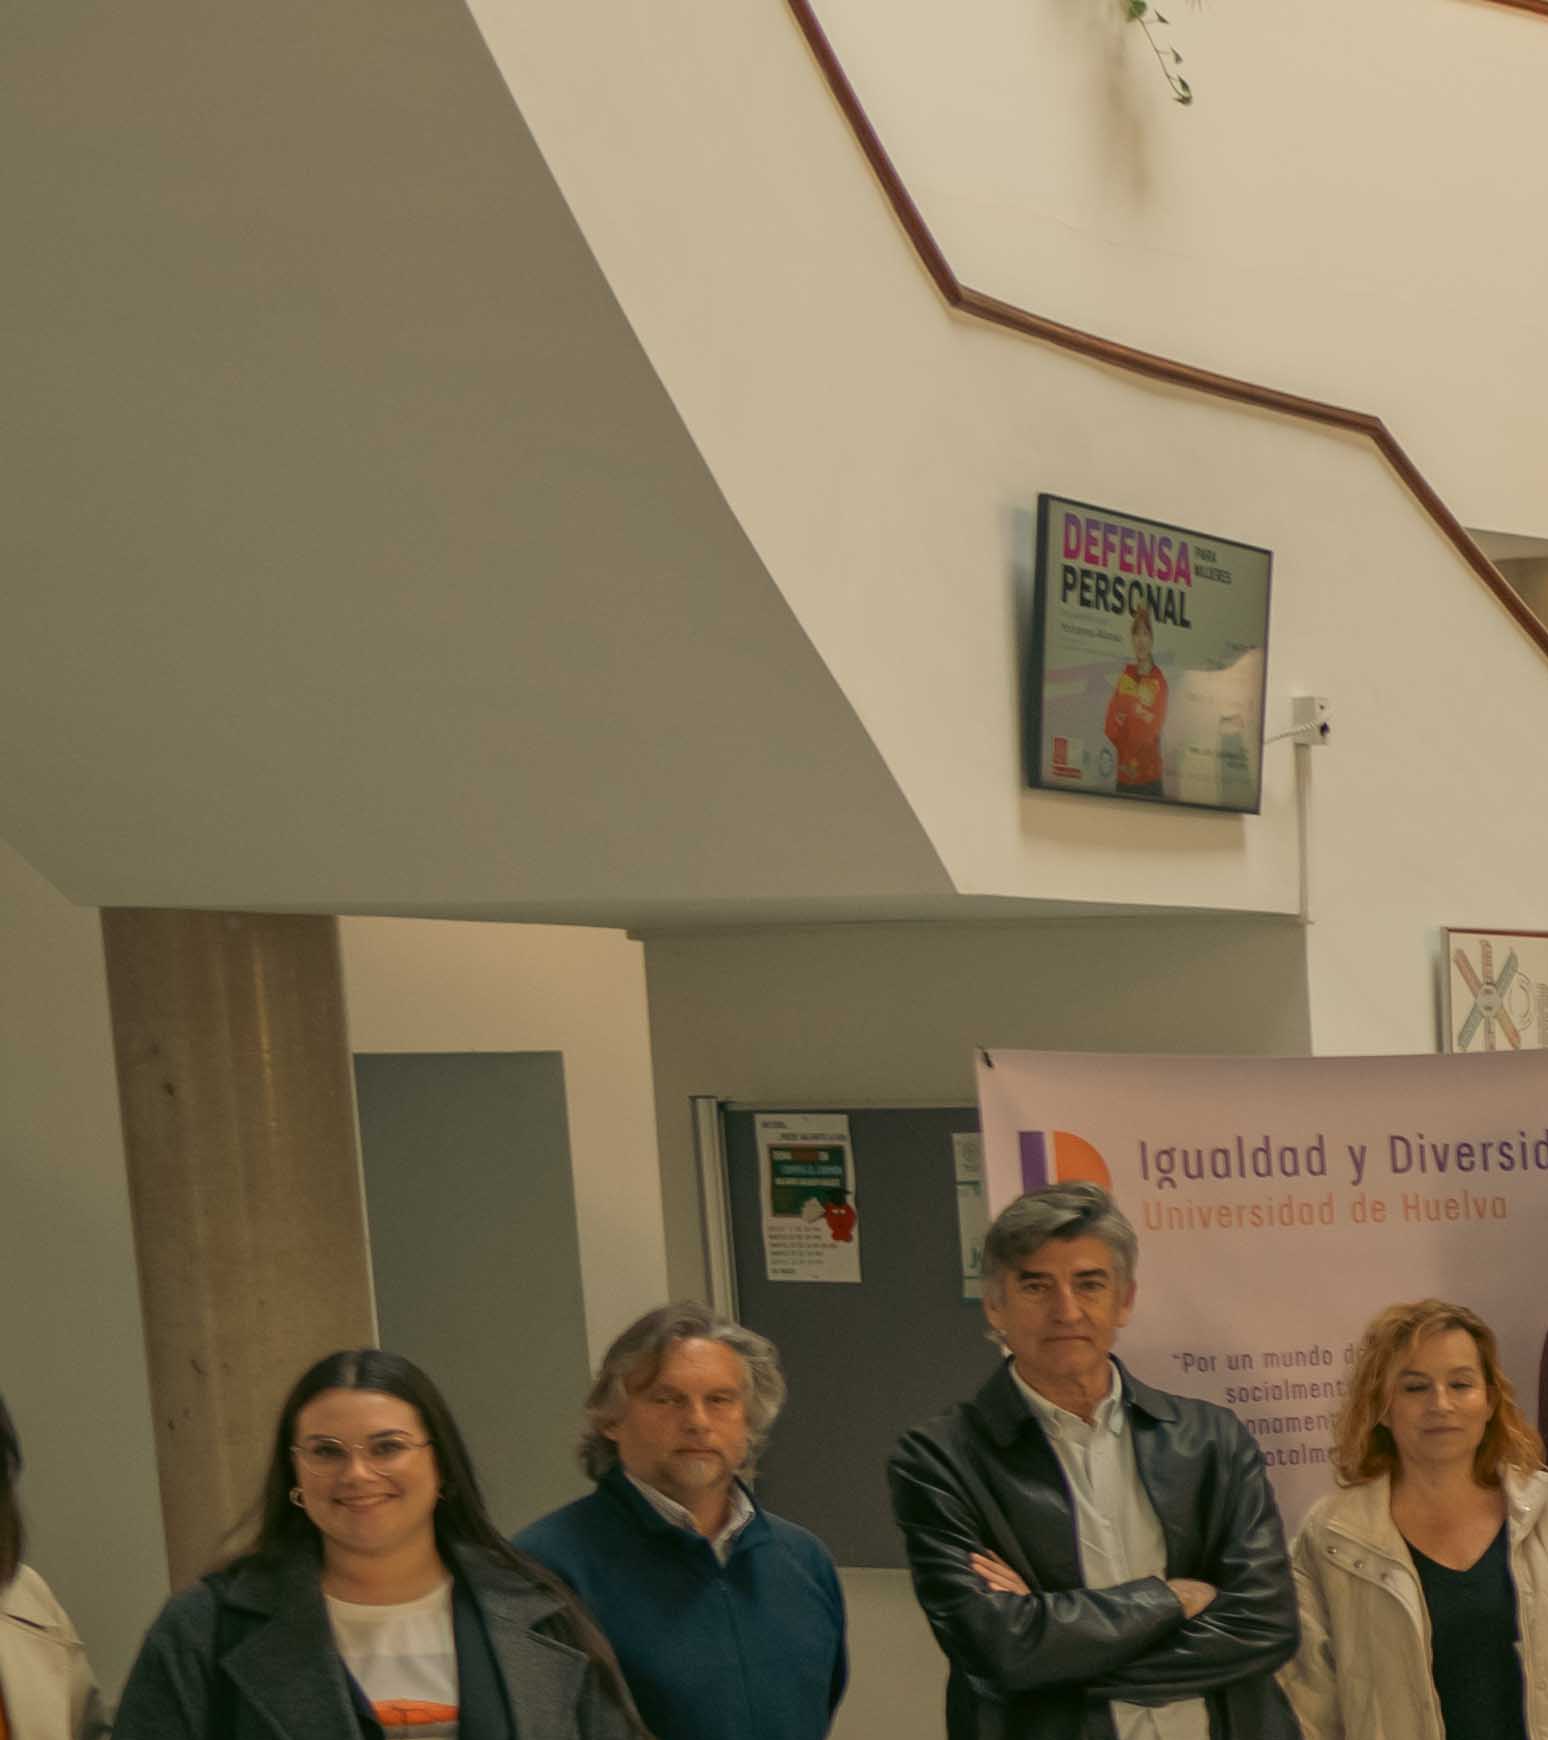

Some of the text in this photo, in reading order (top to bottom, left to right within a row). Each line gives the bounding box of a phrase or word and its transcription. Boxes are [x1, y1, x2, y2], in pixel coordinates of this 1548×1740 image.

[1063, 512, 1192, 588] DEFENSA
[1062, 564, 1192, 630] PERSONAL
[1138, 1134, 1327, 1190] Igualdad
[1347, 1143, 1368, 1187] y
[1143, 1189, 1509, 1232] Universidad de Huelva
[1226, 1354, 1254, 1371] un
[1264, 1345, 1333, 1369] mundo
[1225, 1380, 1345, 1404] socialment
[1247, 1414, 1334, 1435] nament
[1265, 1444, 1330, 1466] otalm
